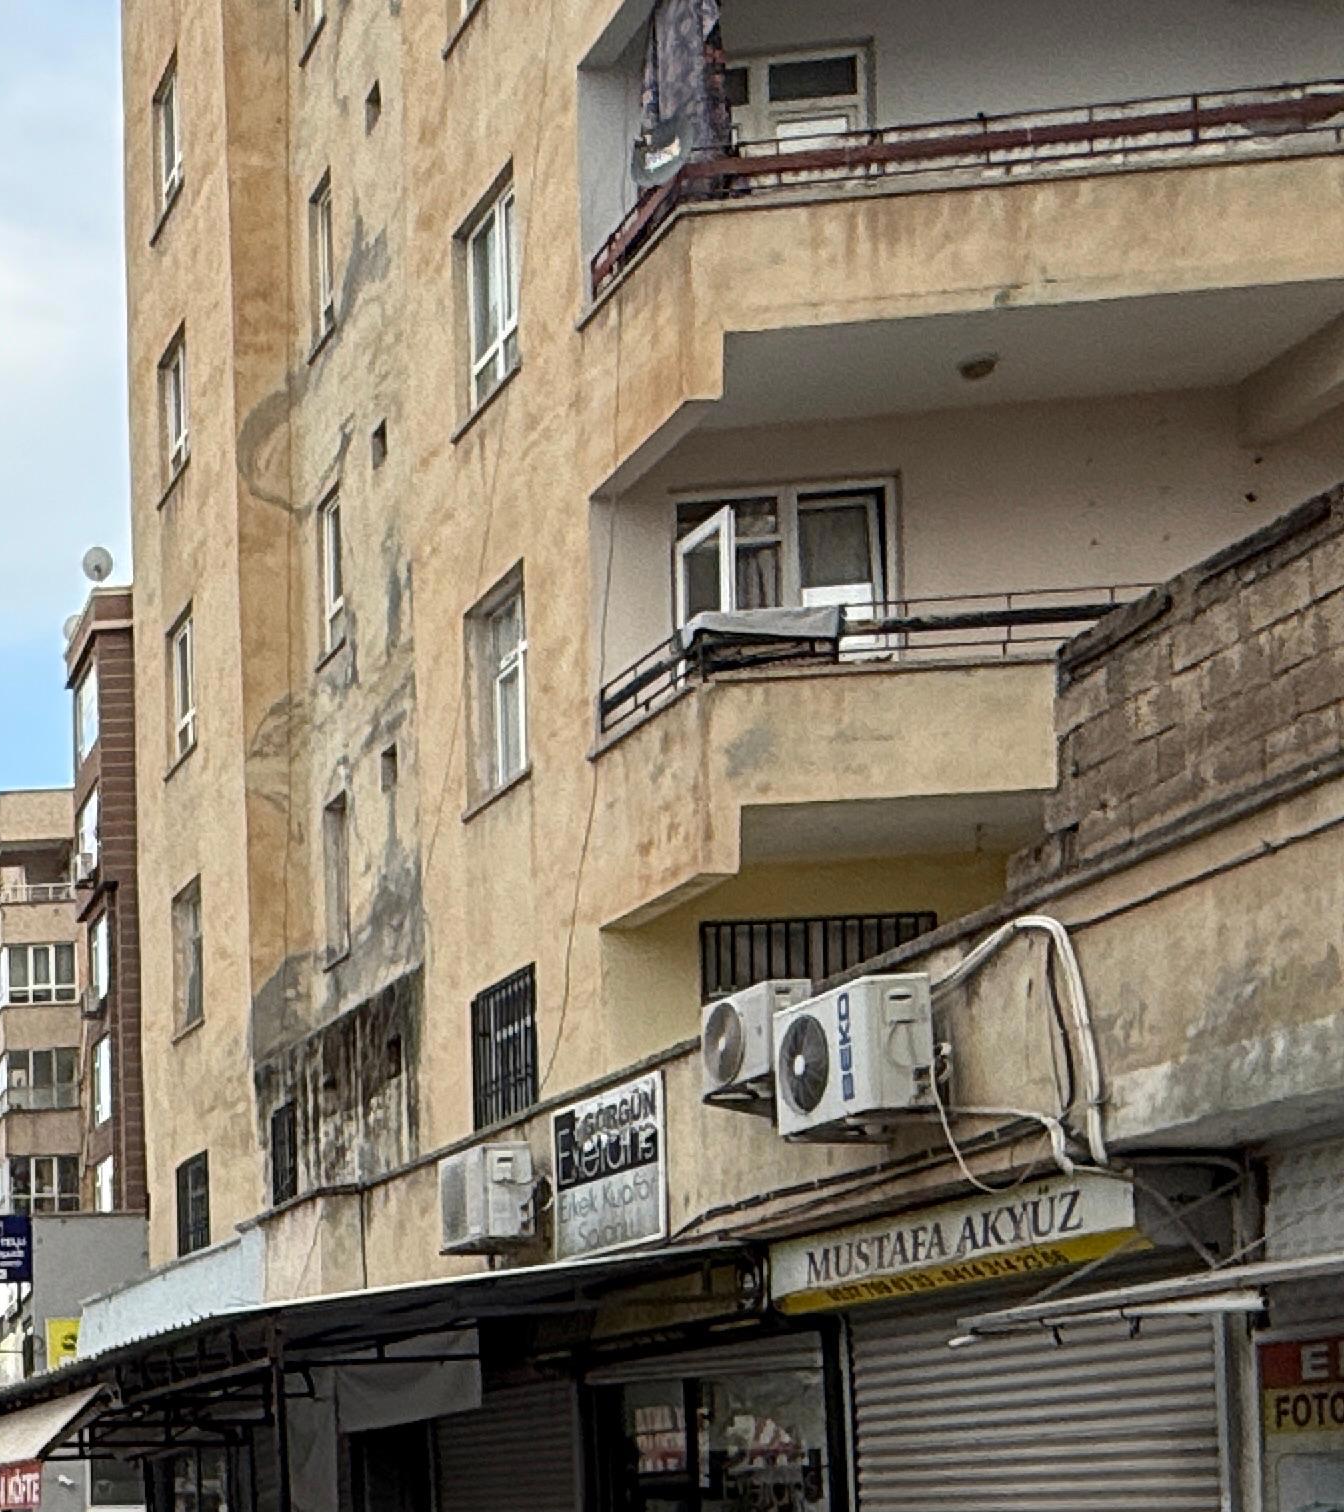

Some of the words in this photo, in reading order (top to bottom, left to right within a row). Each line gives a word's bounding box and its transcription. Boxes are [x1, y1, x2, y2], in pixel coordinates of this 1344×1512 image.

[837, 992, 855, 1101] BEKO
[807, 1221, 948, 1288] MUSTAFA
[958, 1186, 1084, 1254] AKYÜZ
